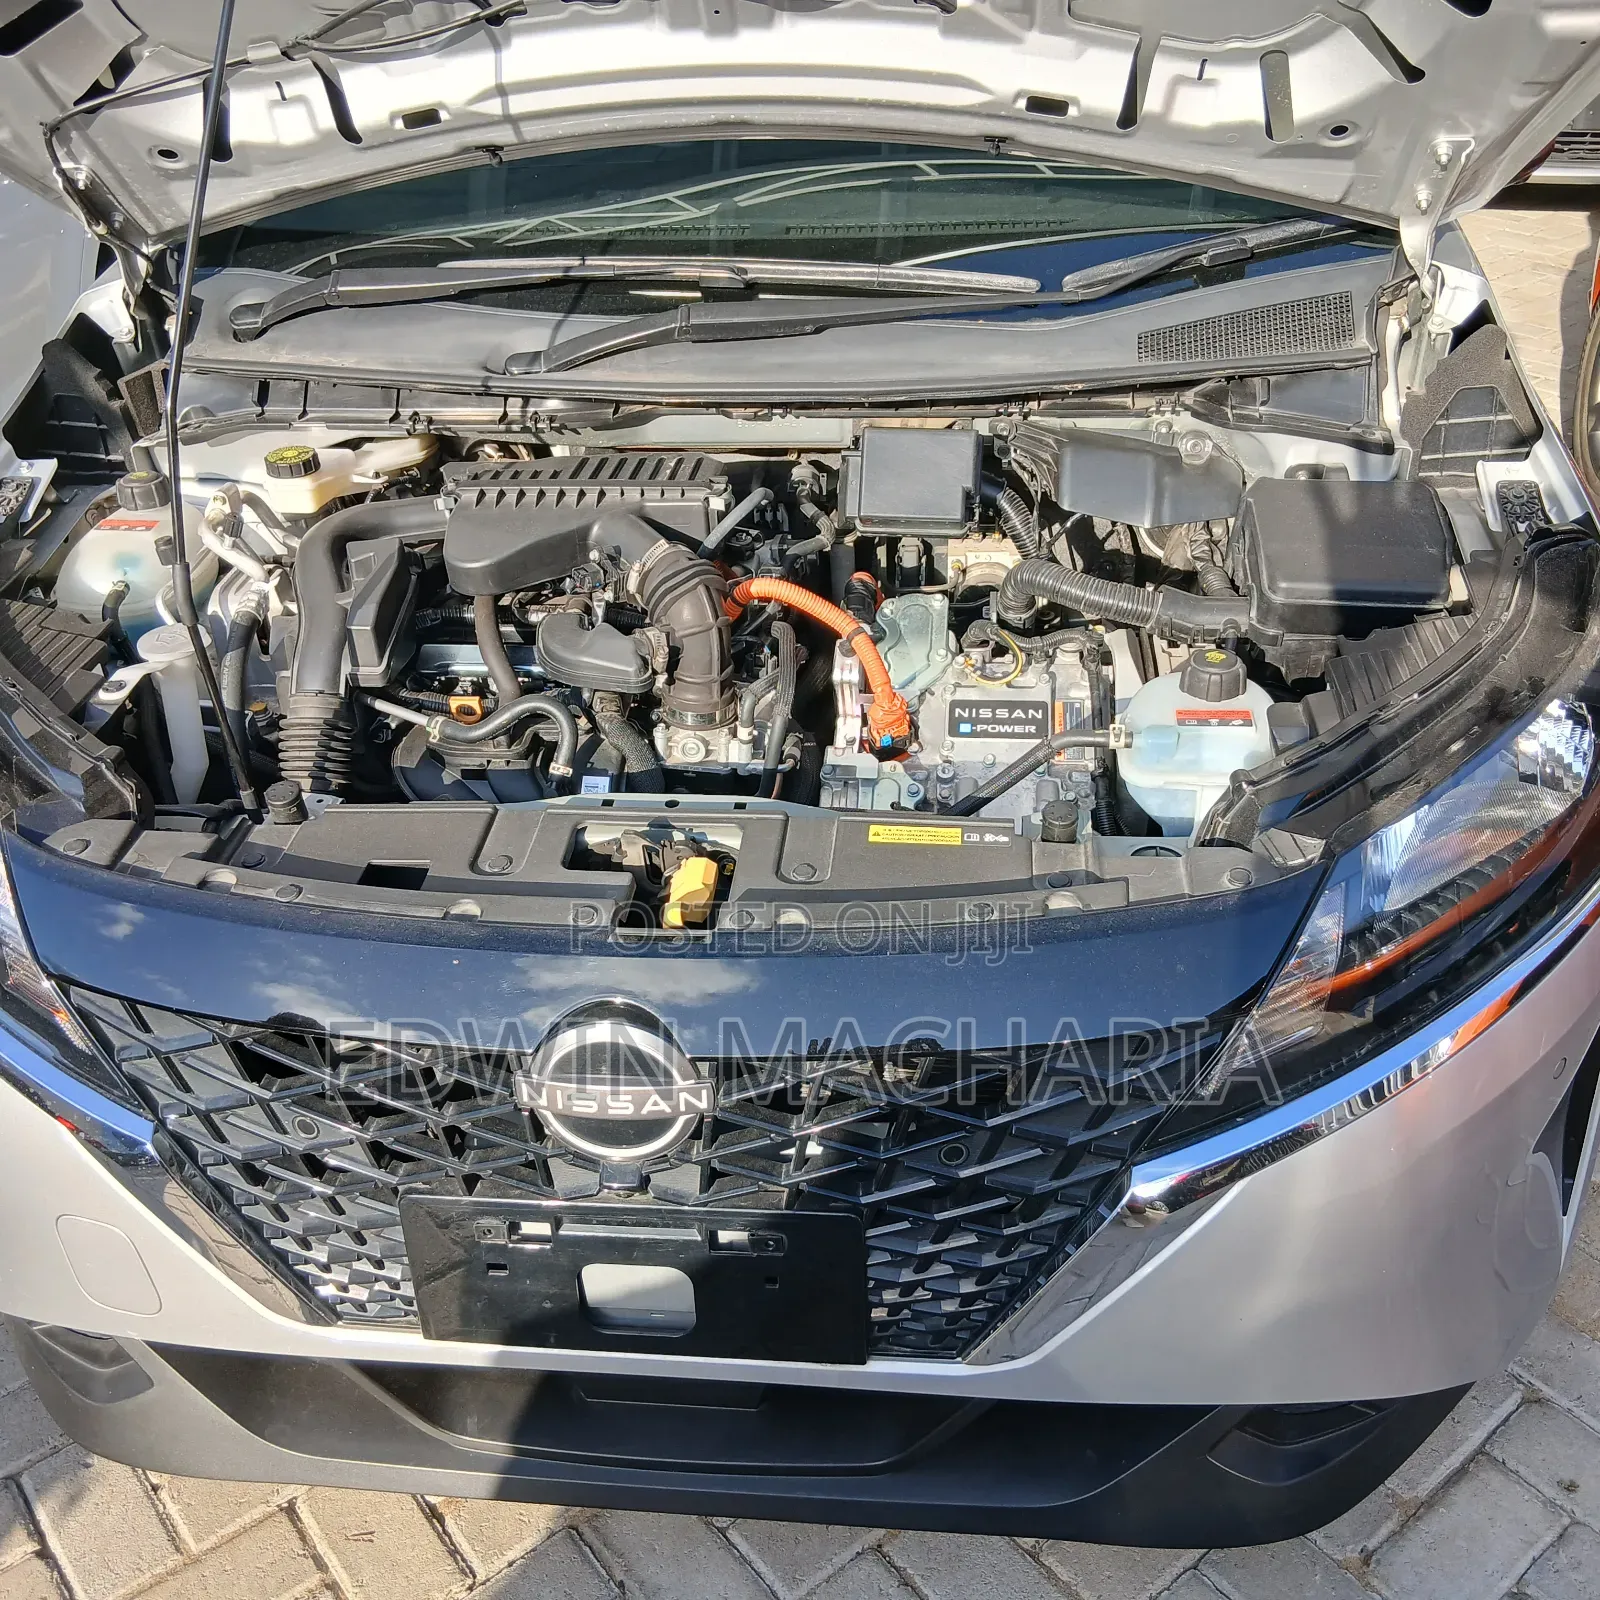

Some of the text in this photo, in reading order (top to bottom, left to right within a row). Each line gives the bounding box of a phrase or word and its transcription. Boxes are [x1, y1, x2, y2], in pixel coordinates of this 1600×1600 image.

[955, 708, 1043, 719] NISSAN
[959, 723, 1037, 734] -POWER
[521, 1082, 708, 1115] NISSAN
